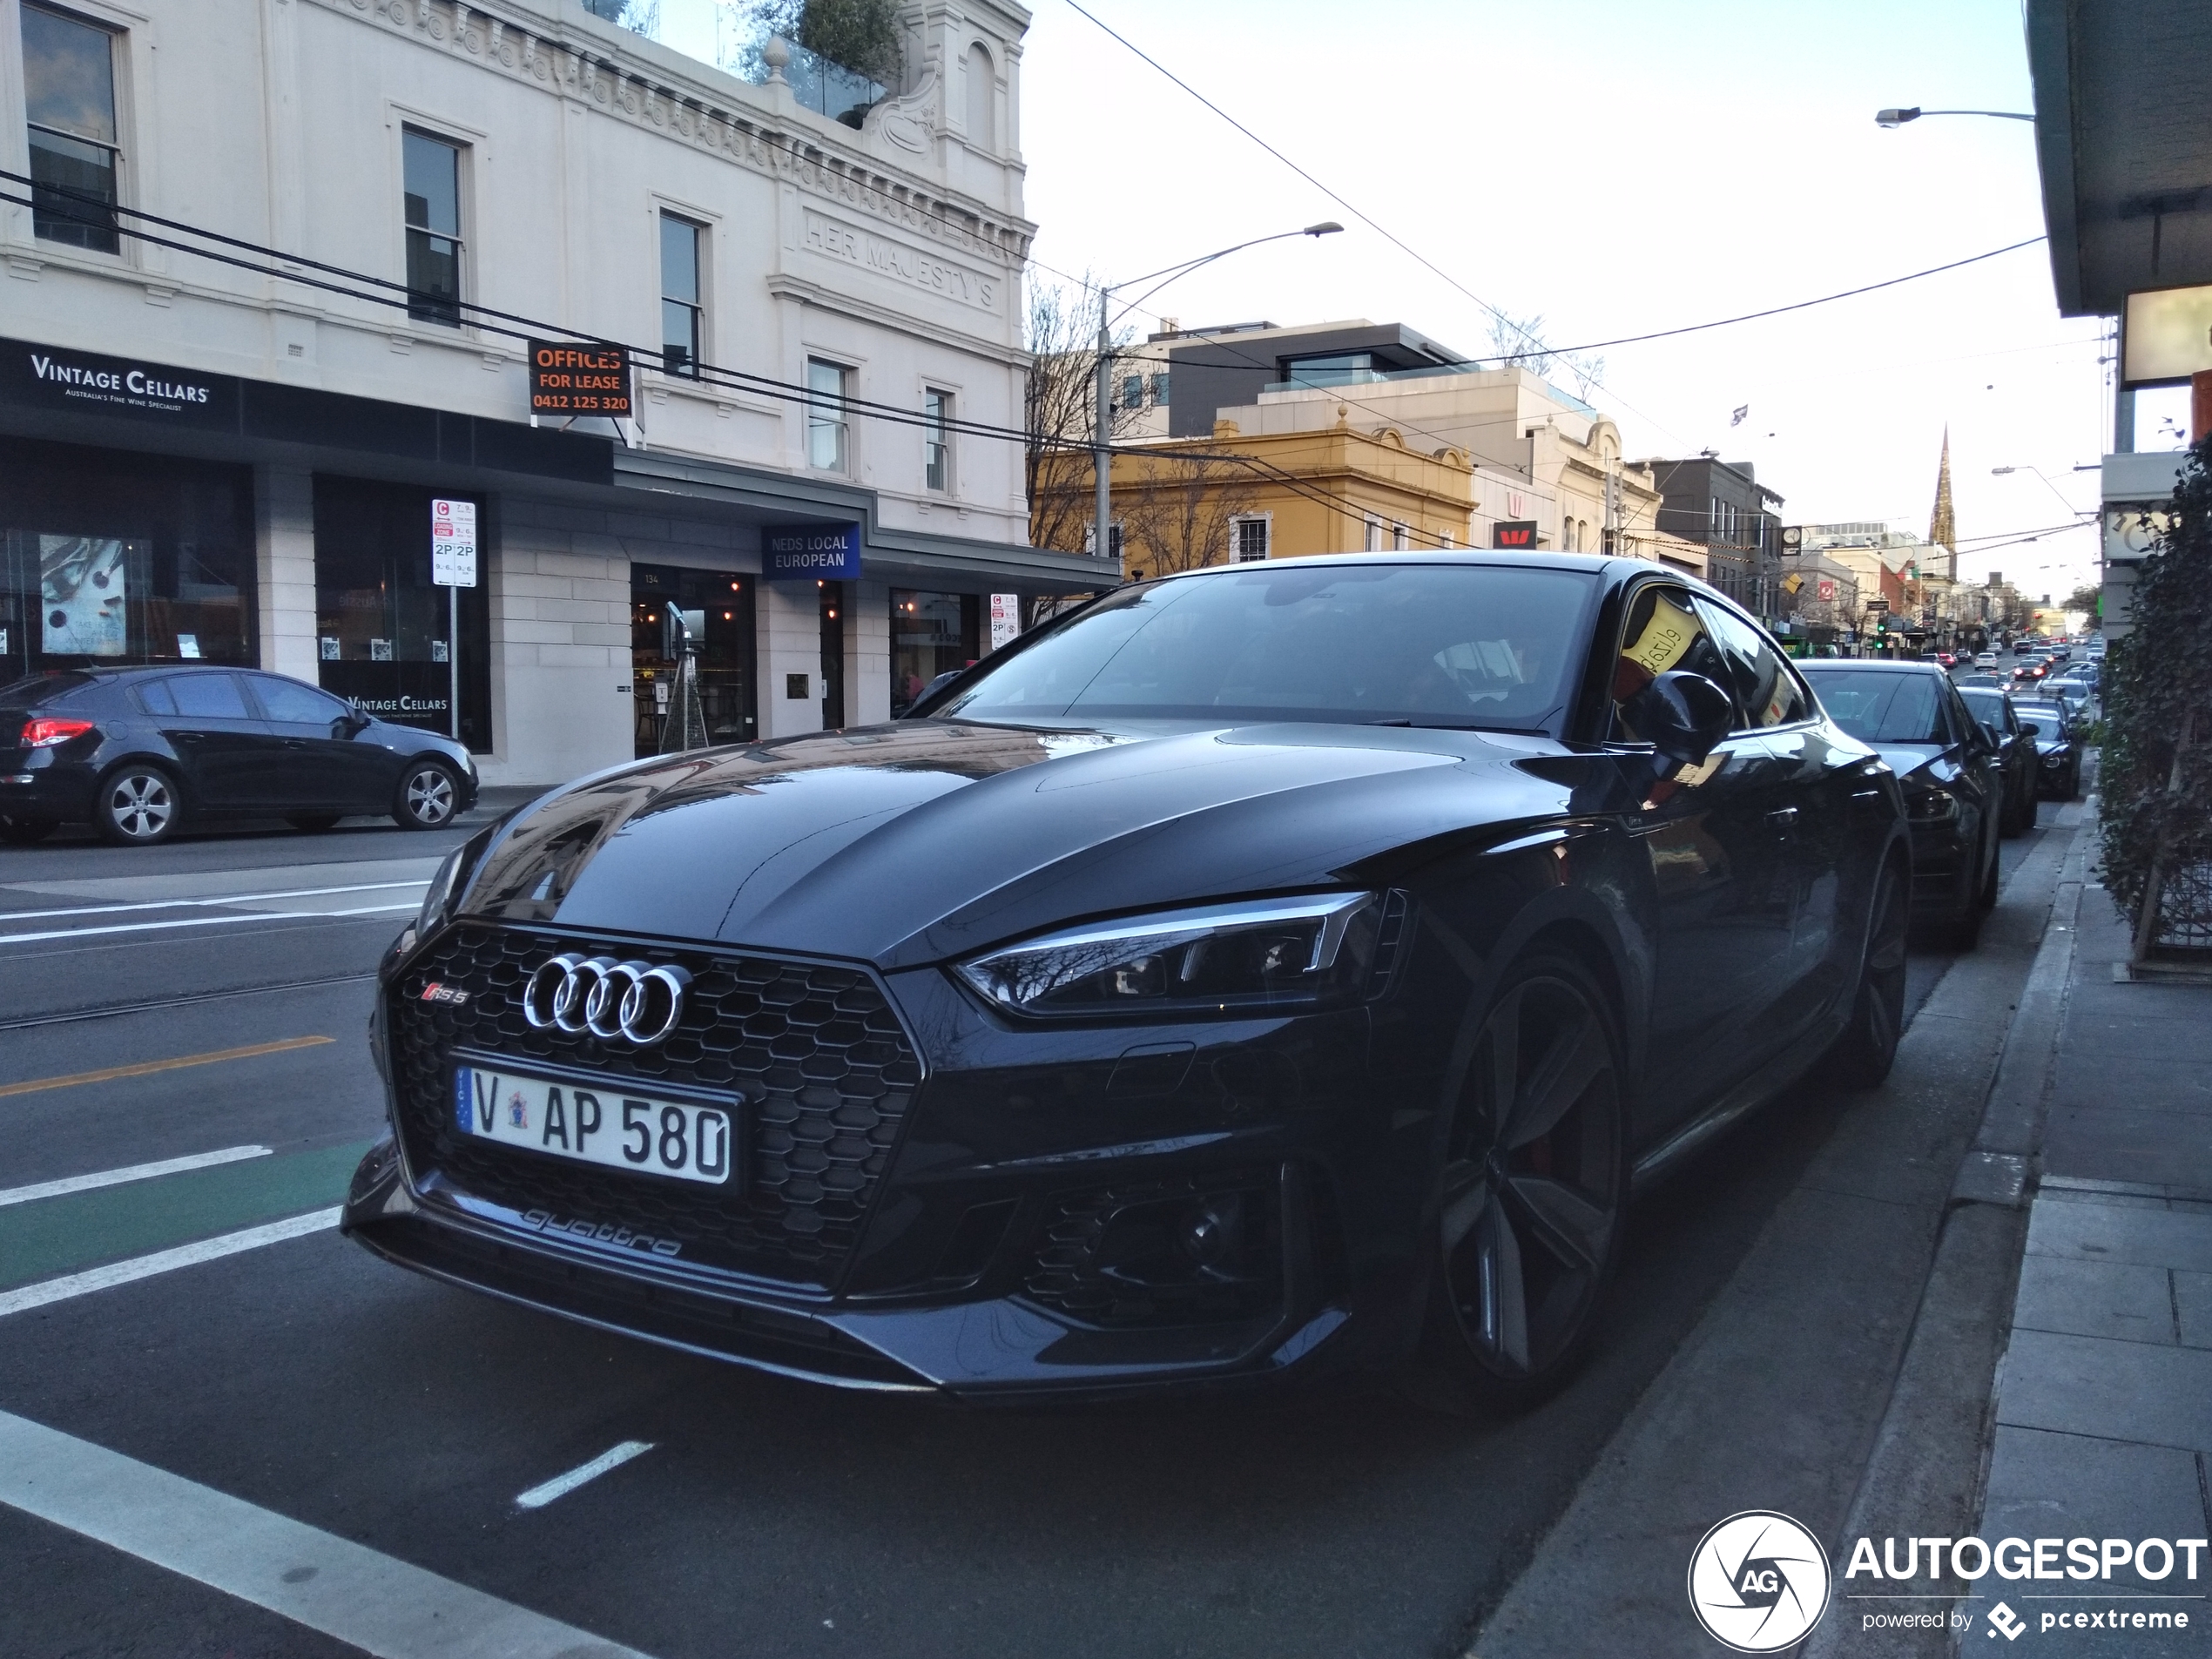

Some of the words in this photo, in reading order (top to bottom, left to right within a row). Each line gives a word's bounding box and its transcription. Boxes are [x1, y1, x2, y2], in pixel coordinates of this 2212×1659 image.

[806, 216, 857, 260] HER
[867, 237, 992, 307] MAJESTY'S
[537, 349, 621, 369] OFFICES
[540, 374, 571, 388] FOR
[576, 375, 620, 389] LEASE
[110, 395, 125, 403] FINE
[128, 398, 146, 407] WINE
[148, 401, 182, 411] SPECIALIST
[534, 395, 569, 408] 0412
[573, 396, 598, 408] 125
[602, 397, 628, 409] 320
[435, 544, 453, 555] 2P
[456, 546, 474, 556] 2P
[772, 538, 803, 551] NEDS
[807, 536, 848, 550] LOCAL
[776, 553, 845, 568] EUROPEAN
[645, 575, 658, 583] 134
[428, 987, 454, 1001] RS
[453, 992, 469, 1004] 5
[475, 1072, 499, 1133] V
[542, 1086, 602, 1154] AP
[622, 1098, 727, 1177] 580
[523, 1207, 683, 1257] quattro
